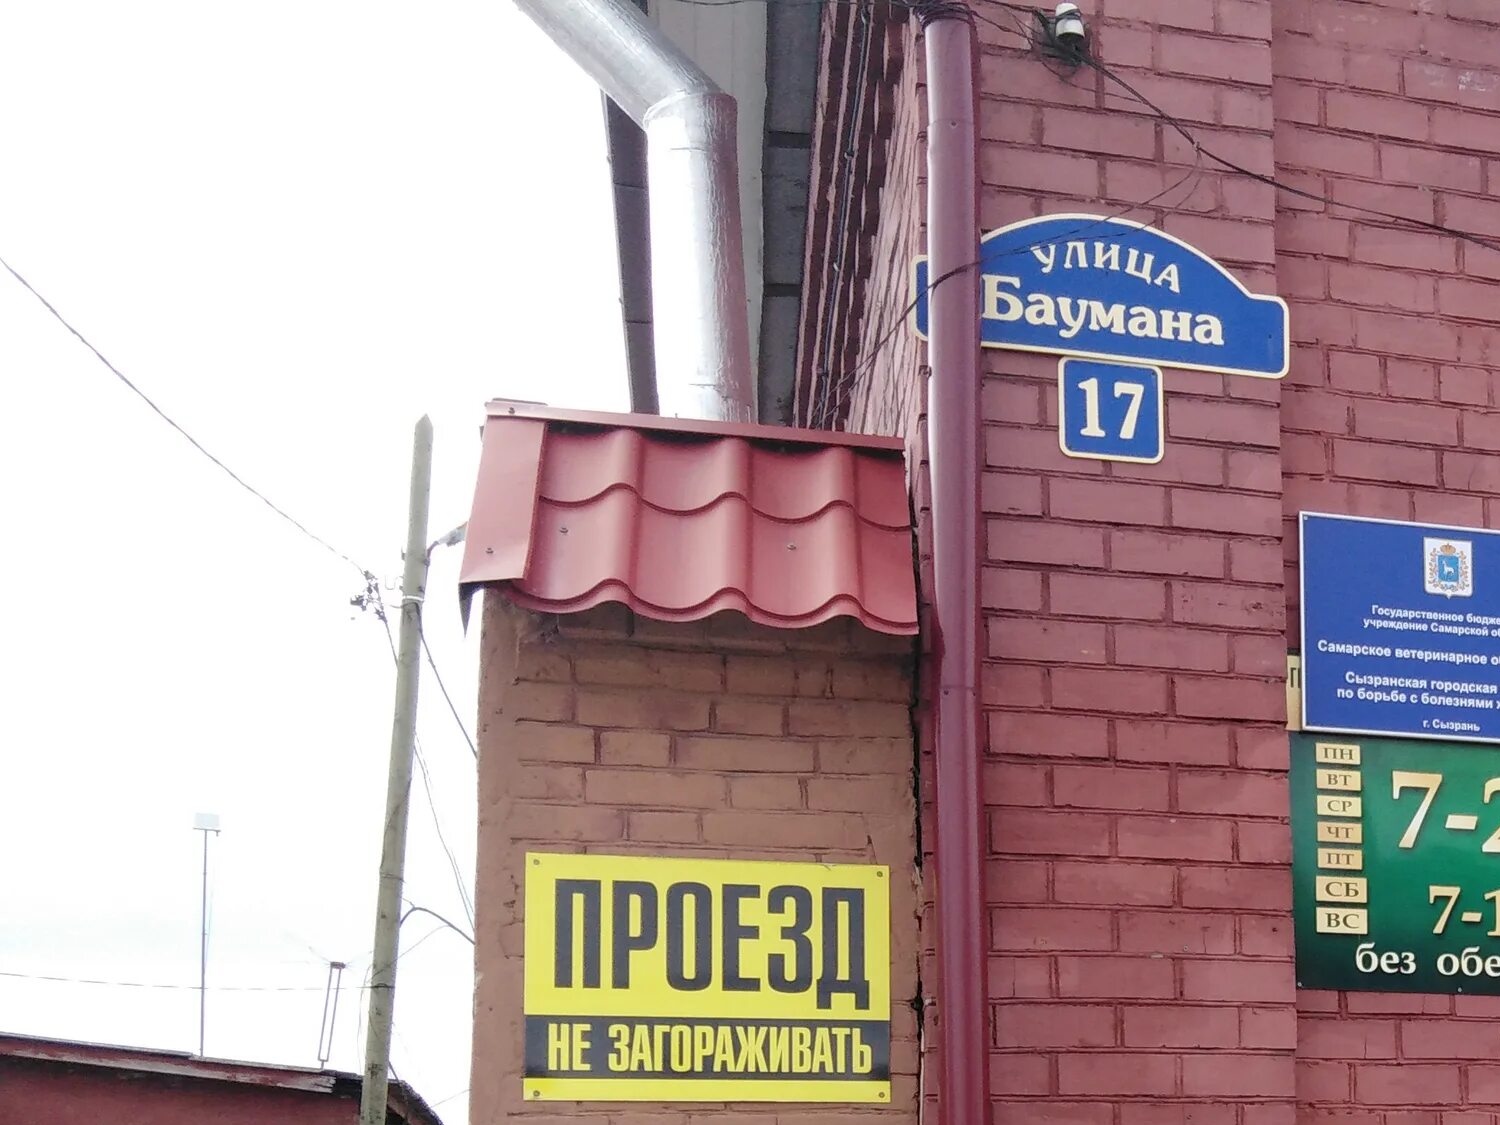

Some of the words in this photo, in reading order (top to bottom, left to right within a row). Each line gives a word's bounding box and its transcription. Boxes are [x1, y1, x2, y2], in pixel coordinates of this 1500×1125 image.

[981, 274, 1225, 346] Баумана
[1076, 376, 1146, 440] 17
[1371, 605, 1464, 622] Государственное
[1363, 618, 1428, 632] учреждение
[1430, 622, 1489, 637] Самарской
[1317, 639, 1392, 659] Самарское
[1395, 647, 1488, 666] ветеринарное
[1345, 671, 1427, 690] Сызранская
[1430, 681, 1498, 696] городская
[1336, 688, 1353, 699] по
[1357, 687, 1406, 703] борьбе
[1410, 693, 1418, 703] с
[1421, 692, 1493, 710] болезнями
[1422, 719, 1430, 728] г.
[1432, 718, 1480, 732] Сызрань
[1323, 746, 1354, 761] ПН
[1326, 773, 1352, 787] ВТ
[1327, 799, 1353, 813] СР
[1327, 825, 1354, 839] ЧТ
[1326, 852, 1355, 866] ПТ
[1324, 881, 1360, 898] СБ
[1326, 913, 1360, 930] ВС
[554, 878, 871, 1011] ПРОЕЗД
[1355, 942, 1417, 975] без
[547, 1022, 592, 1072] НЕ
[607, 1023, 873, 1075] ЗАГОРАЖИВАТЬ
